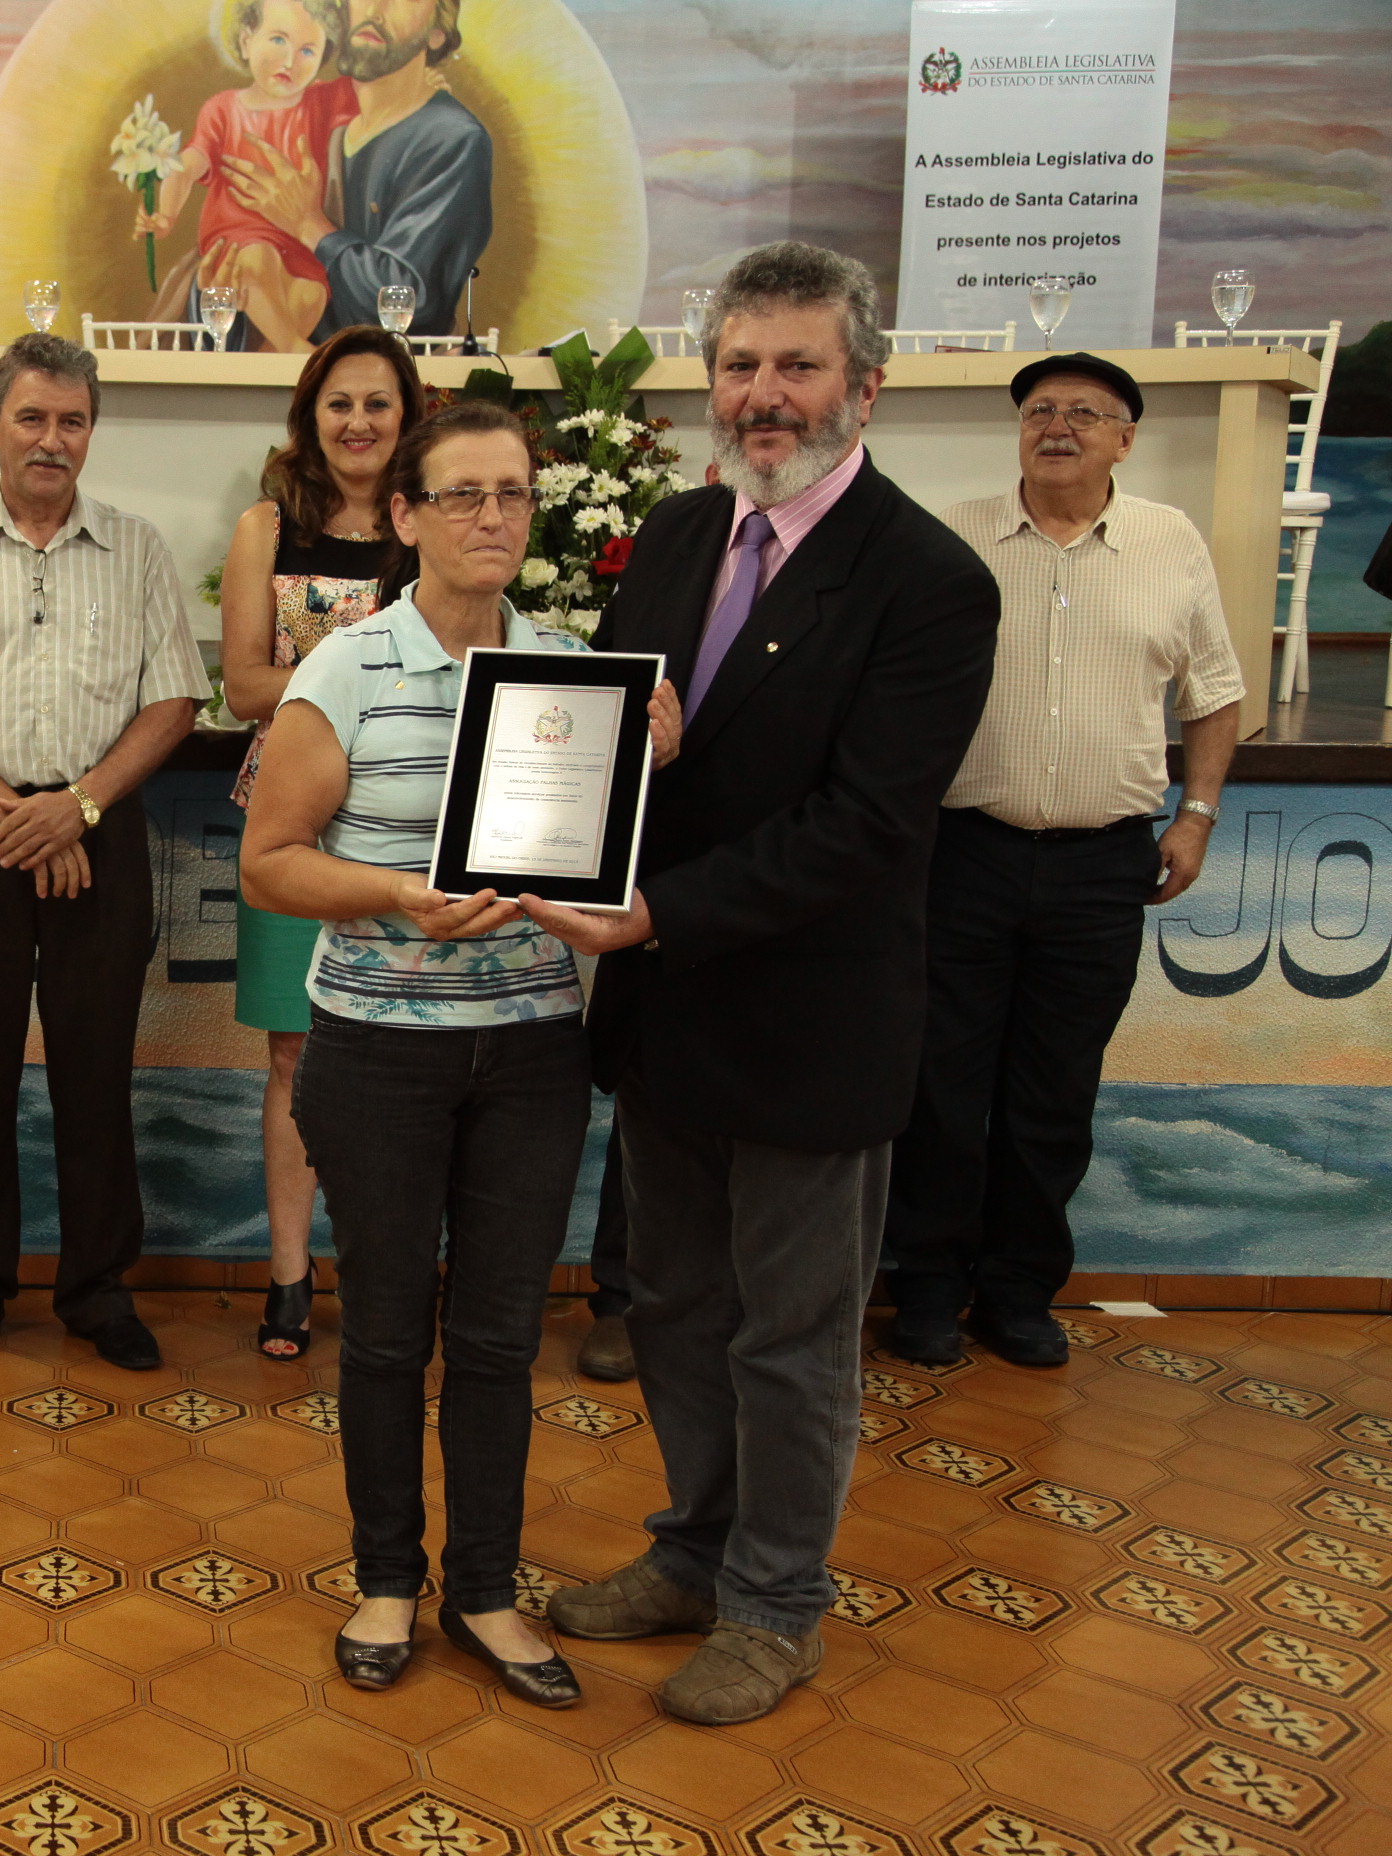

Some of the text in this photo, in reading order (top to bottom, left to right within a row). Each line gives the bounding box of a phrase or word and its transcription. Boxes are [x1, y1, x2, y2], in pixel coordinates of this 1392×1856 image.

[970, 54, 1155, 70] ASSEMBLEIA LEGISLATIVA
[968, 74, 1155, 87] DO ESTADO DE SANTA CATARINA
[915, 151, 1154, 169] A Assembleia Legislativa do
[925, 191, 1138, 208] Estado de Santa Catarina
[937, 232, 1121, 251] presente nos projetos
[957, 272, 1097, 288] de interioção
